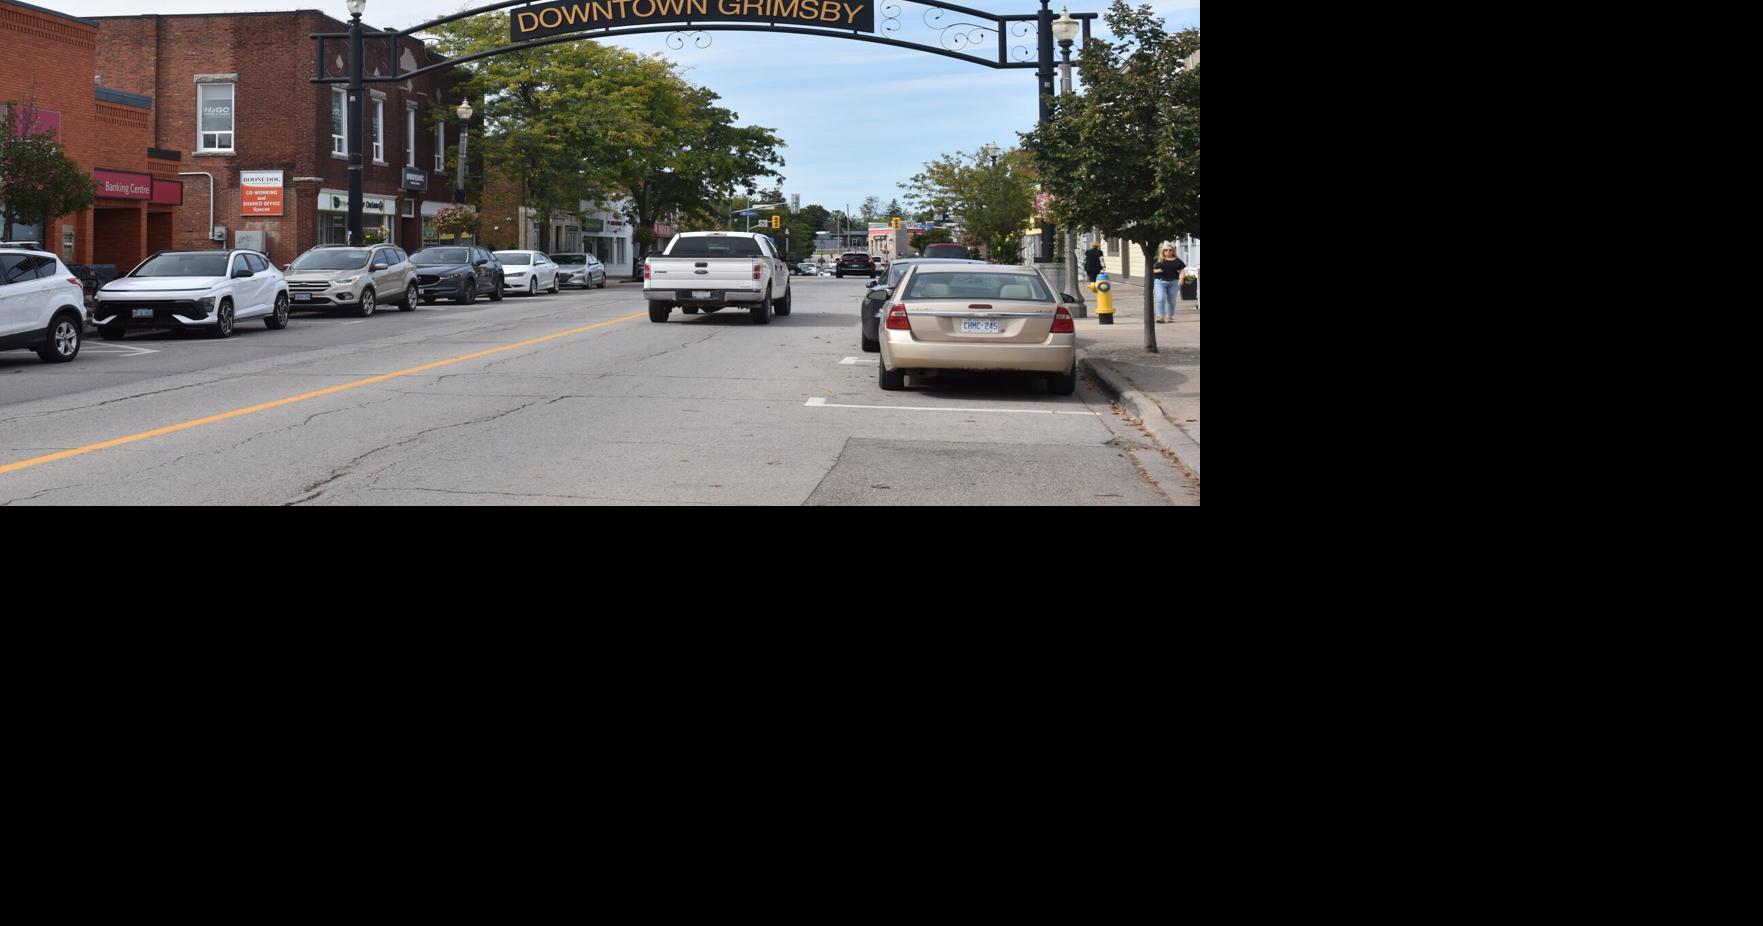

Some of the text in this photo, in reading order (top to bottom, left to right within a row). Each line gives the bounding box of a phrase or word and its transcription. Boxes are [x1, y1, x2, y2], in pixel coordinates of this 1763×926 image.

[517, 0, 864, 33] DOWNTOWN GRIMSBY
[105, 181, 151, 195] Banking Centre
